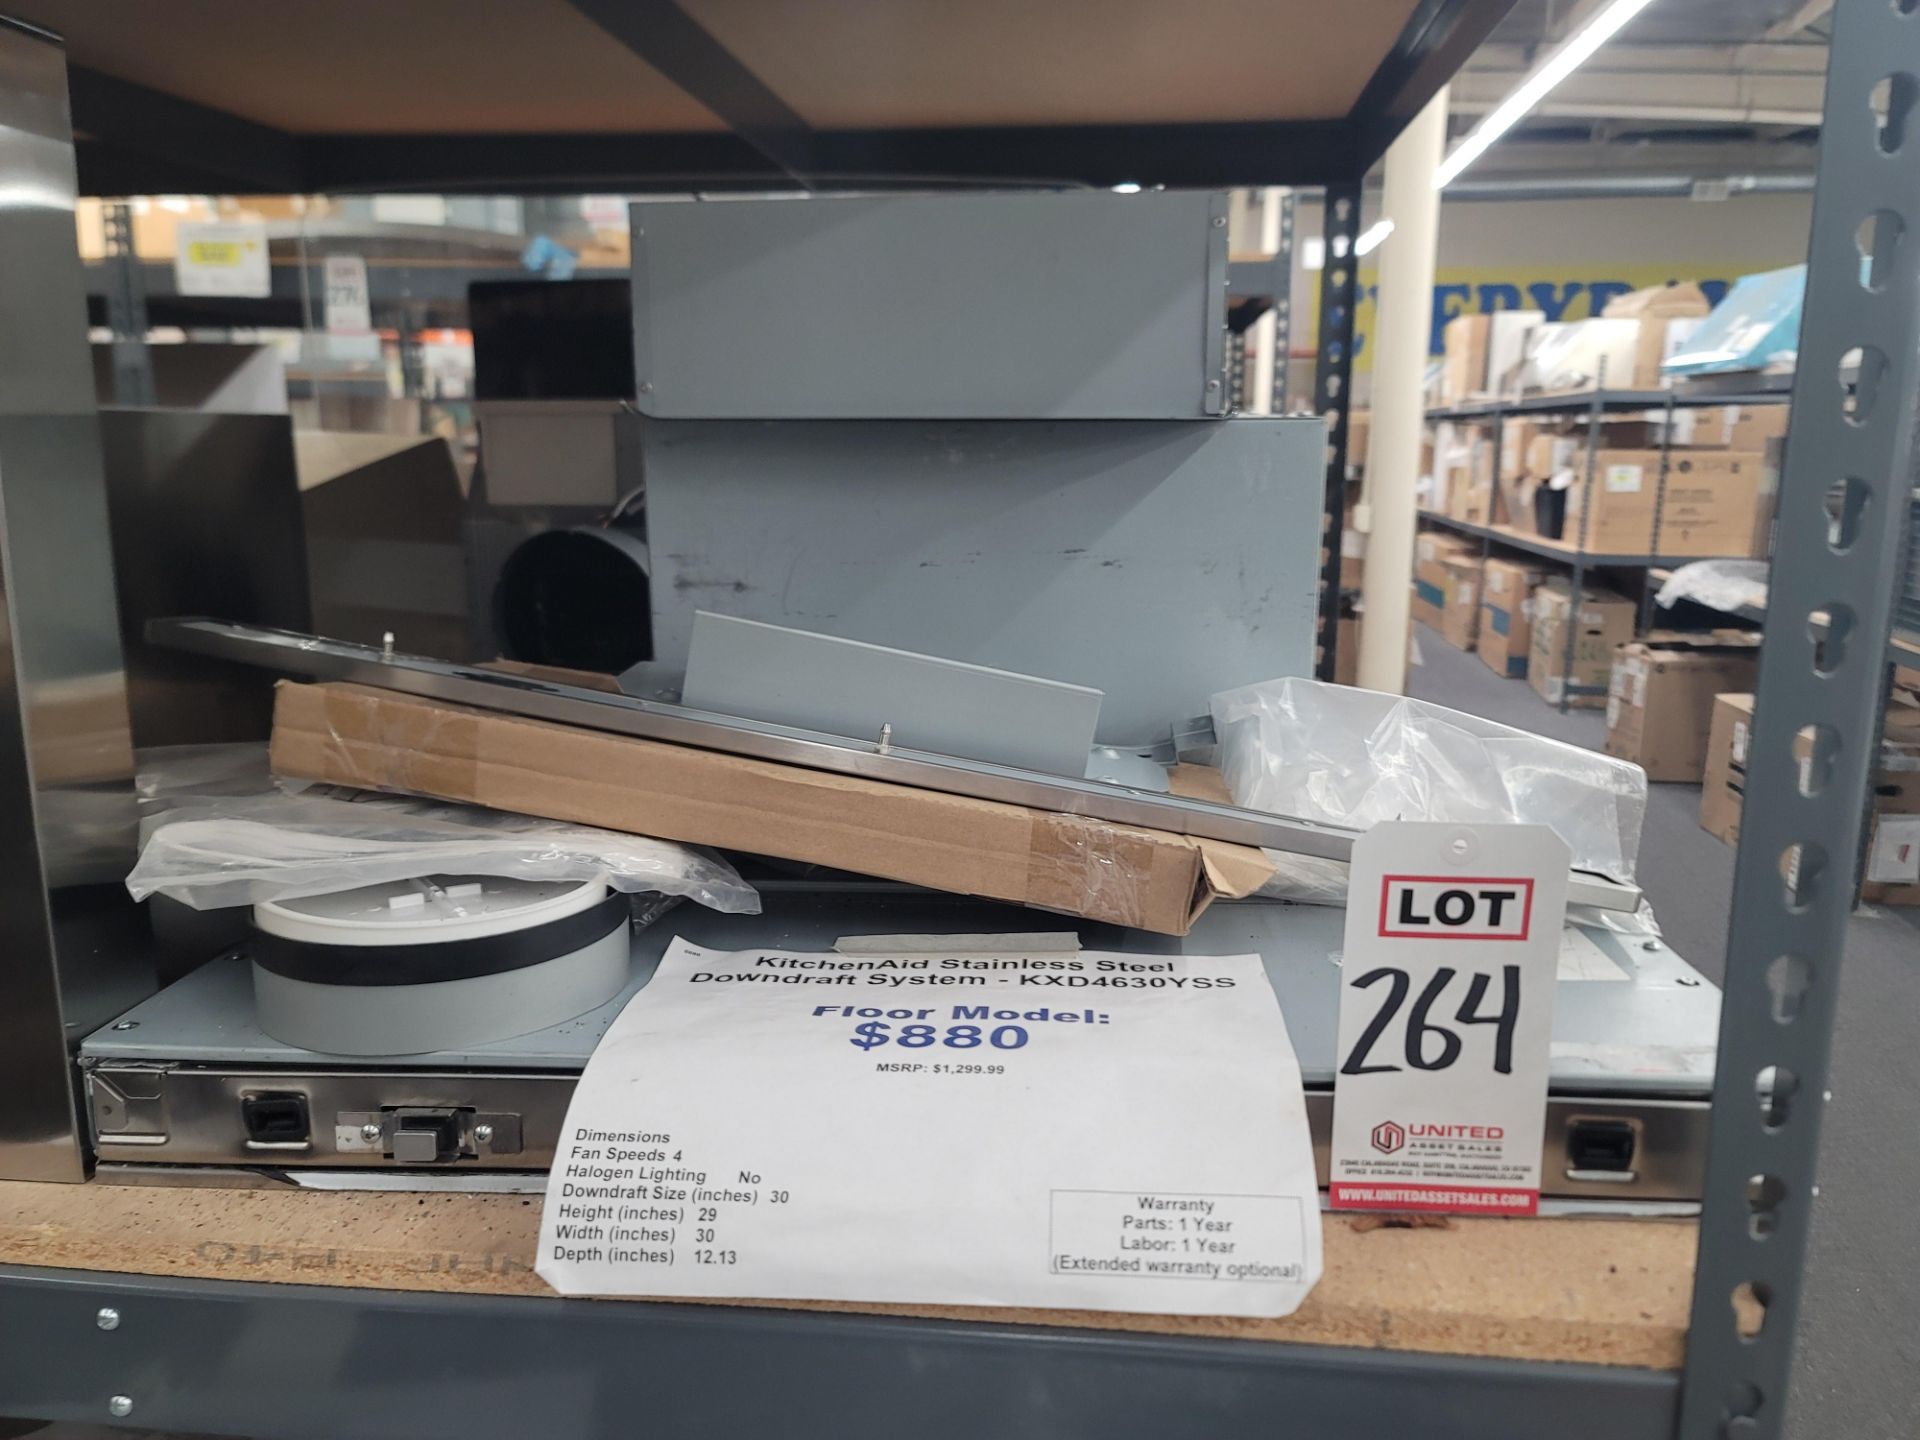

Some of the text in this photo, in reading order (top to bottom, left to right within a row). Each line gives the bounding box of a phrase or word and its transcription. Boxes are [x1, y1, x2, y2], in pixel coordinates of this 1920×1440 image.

[1398, 888, 1515, 927] LOT
[755, 956, 1173, 973] KitchenAid Stainless Steel
[689, 972, 857, 986] Downdraft
[867, 973, 986, 987] System
[1020, 975, 1236, 989] KXD4630YSS
[812, 1005, 1110, 1024] Floor Model:
[1340, 965, 1520, 1075] 264
[850, 1021, 1029, 1051] $880
[876, 1063, 1005, 1075] MSRP: $1,299.99
[575, 1128, 671, 1144] Dimensions
[1408, 1124, 1504, 1139] UNITED
[570, 1147, 682, 1163] Fan Speeds 4
[566, 1165, 761, 1184] Halogen Lighting No
[562, 1184, 789, 1205] Downdraft Size (inches) 30
[1338, 1188, 1530, 1207] WWW.UNITEDASSETSALES.COM
[559, 1204, 717, 1224] Height (inches) 29
[1137, 1196, 1215, 1215] Warranty
[1122, 1215, 1233, 1232] Parts: 1 Year
[556, 1225, 715, 1244] Width (inches) 30
[1120, 1236, 1236, 1253] Labor: 1 Year
[553, 1246, 737, 1265] Depth (inches) 12.13
[1053, 1255, 1302, 1279] (Extended warranty optional)
